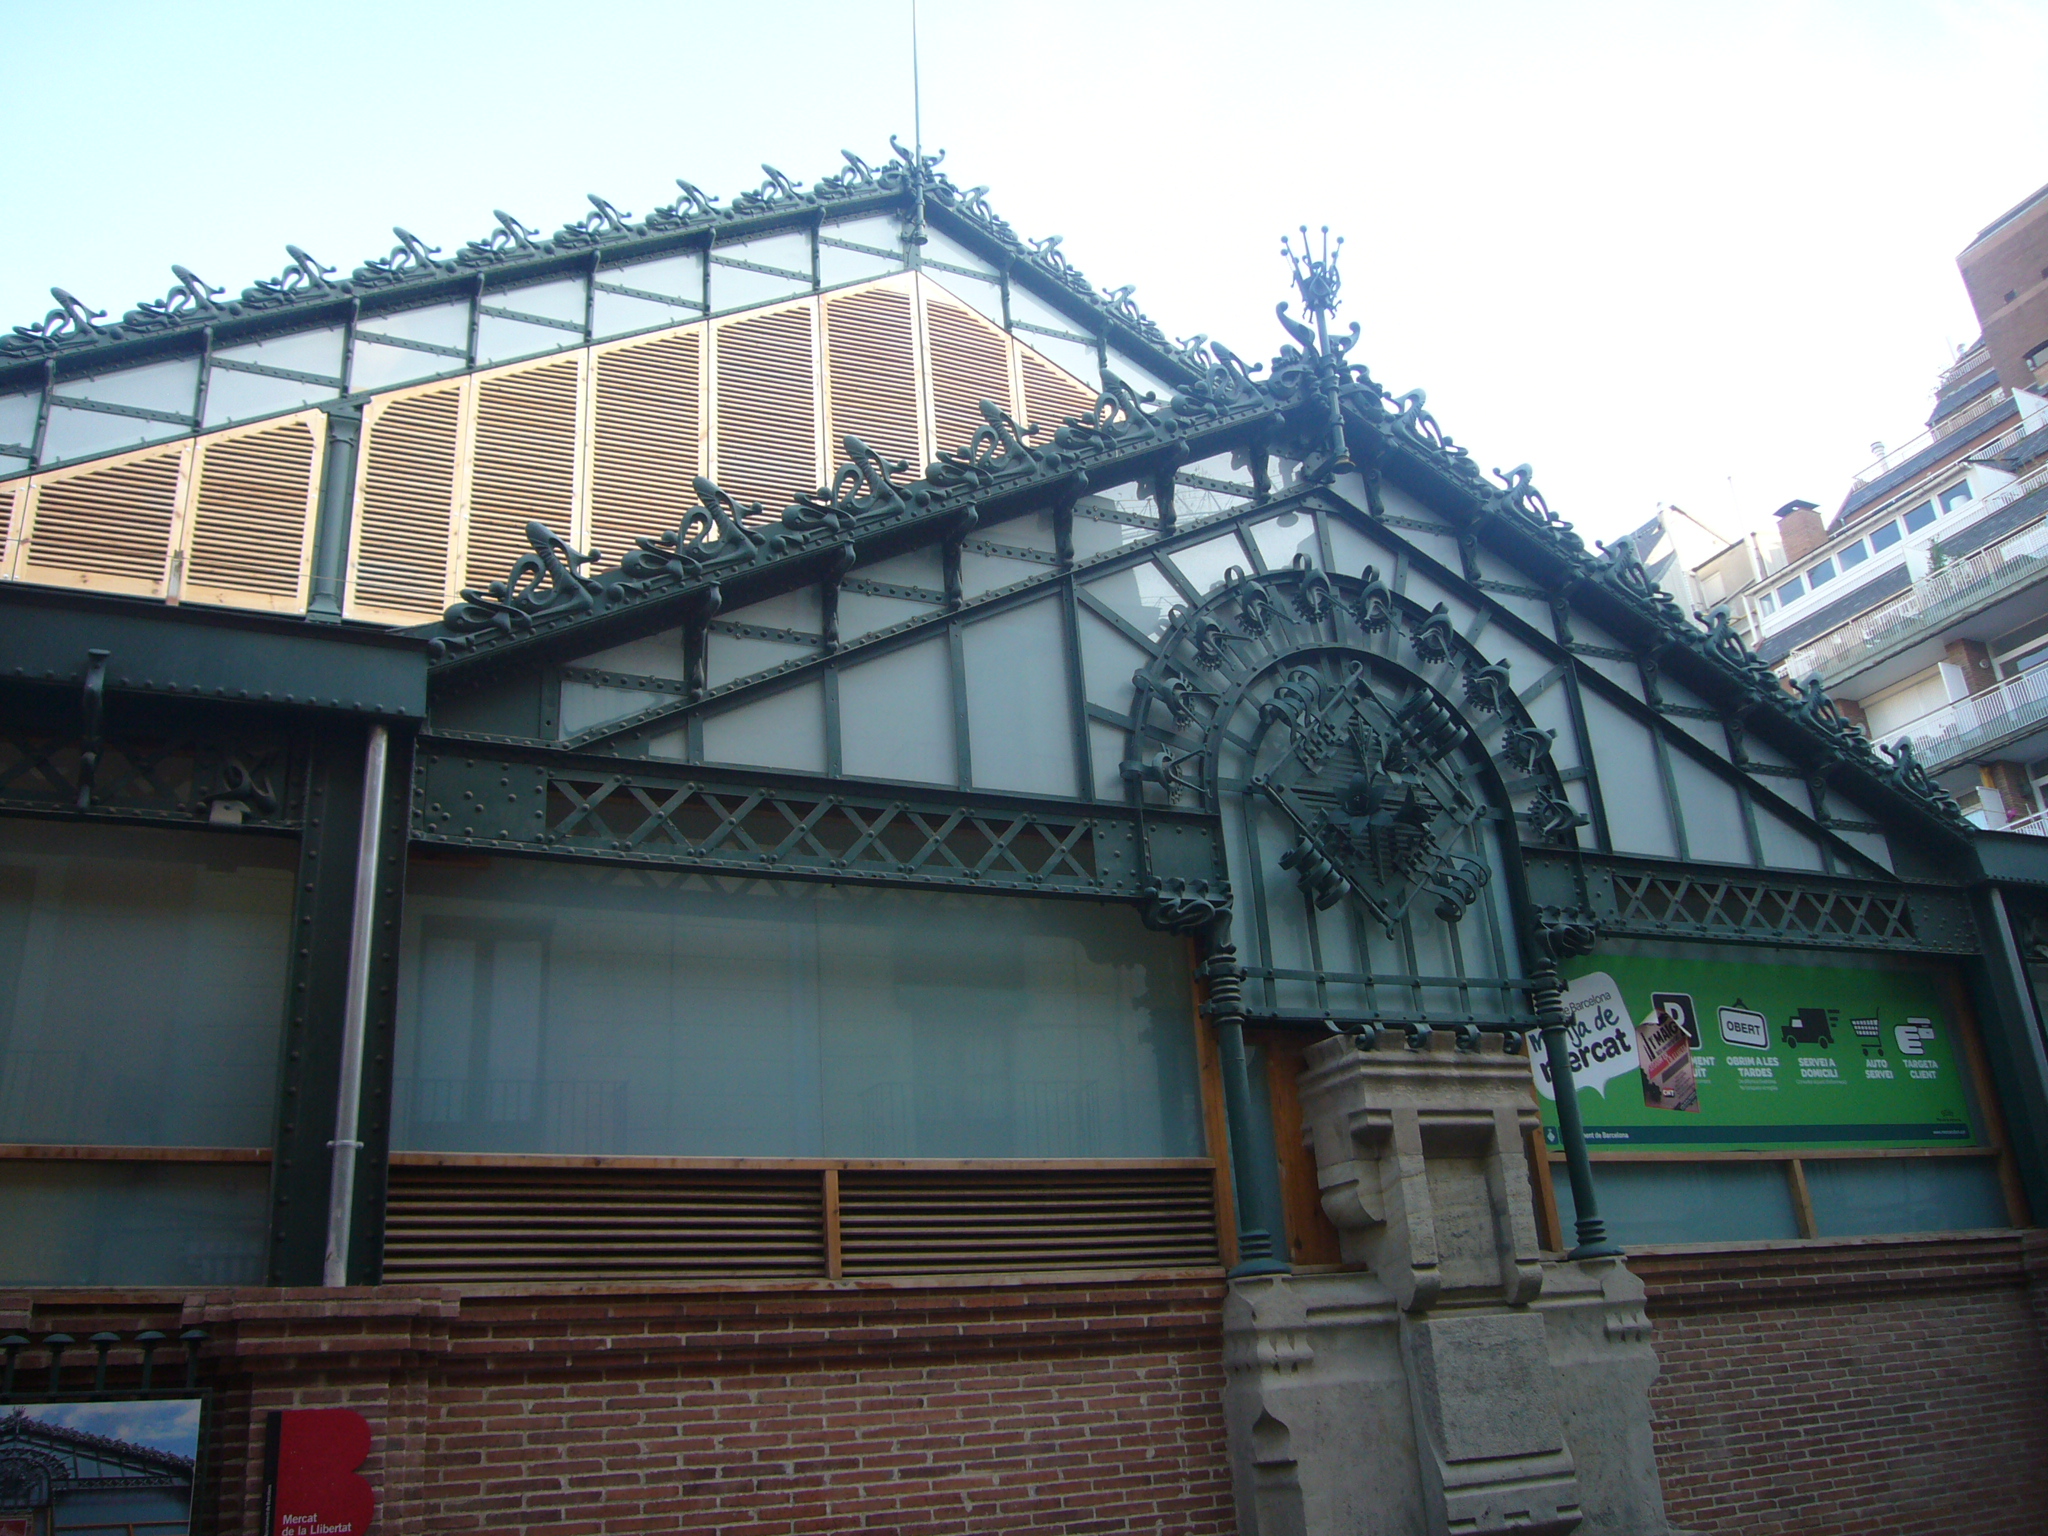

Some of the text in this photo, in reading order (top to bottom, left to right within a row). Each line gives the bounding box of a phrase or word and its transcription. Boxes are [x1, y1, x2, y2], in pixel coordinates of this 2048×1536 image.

[1568, 991, 1612, 1014] Barcelona
[1594, 1004, 1620, 1032] de
[1726, 1020, 1760, 1036] OBERT
[1726, 1056, 1755, 1066] OBRIM
[1756, 1057, 1762, 1067] A
[1762, 1057, 1779, 1067] LES
[1798, 1057, 1837, 1067] SERVEI A
[1866, 1059, 1888, 1068] AUTO
[1902, 1059, 1939, 1069] TARGETA
[1738, 1067, 1773, 1078] TARDES
[1800, 1068, 1839, 1078] DOMICILI
[1865, 1070, 1894, 1079] SERVEI
[1909, 1070, 1937, 1079] CLIENT
[282, 1513, 318, 1525] Mercat
[281, 1522, 352, 1536] de la Llibertat
